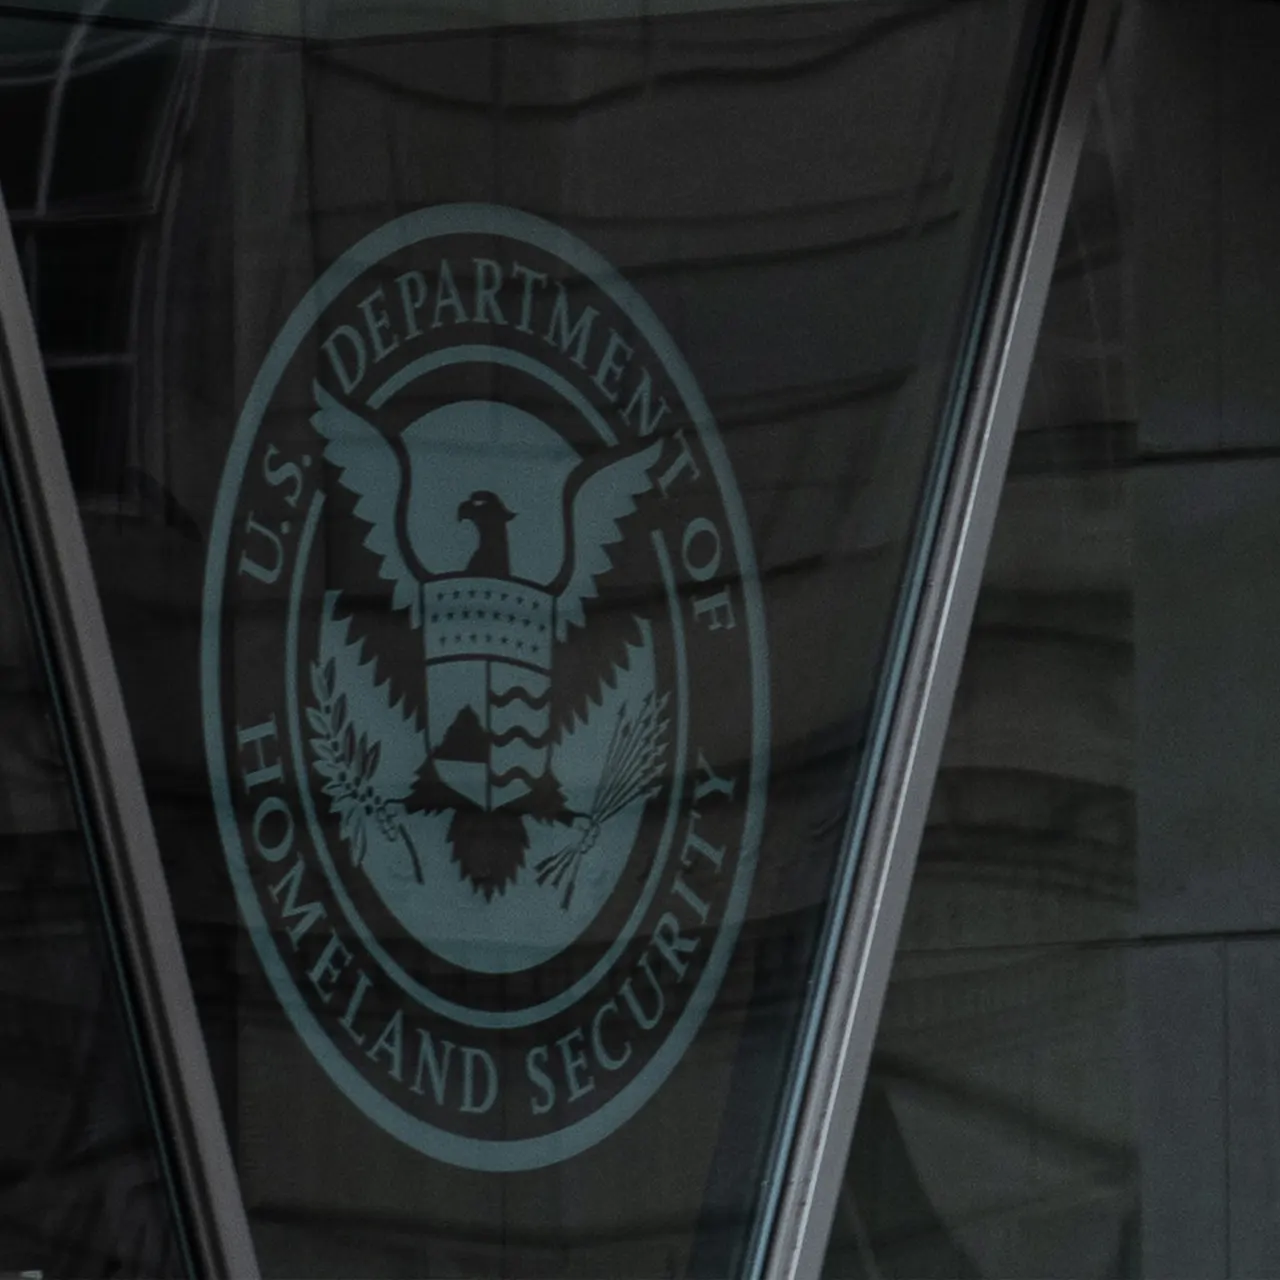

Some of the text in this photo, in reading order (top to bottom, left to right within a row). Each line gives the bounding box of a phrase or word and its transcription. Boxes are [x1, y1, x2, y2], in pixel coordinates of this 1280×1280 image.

[238, 256, 736, 631] U.S. DEPARTMENT OF
[237, 713, 738, 1115] HOMELAND SECURITY
